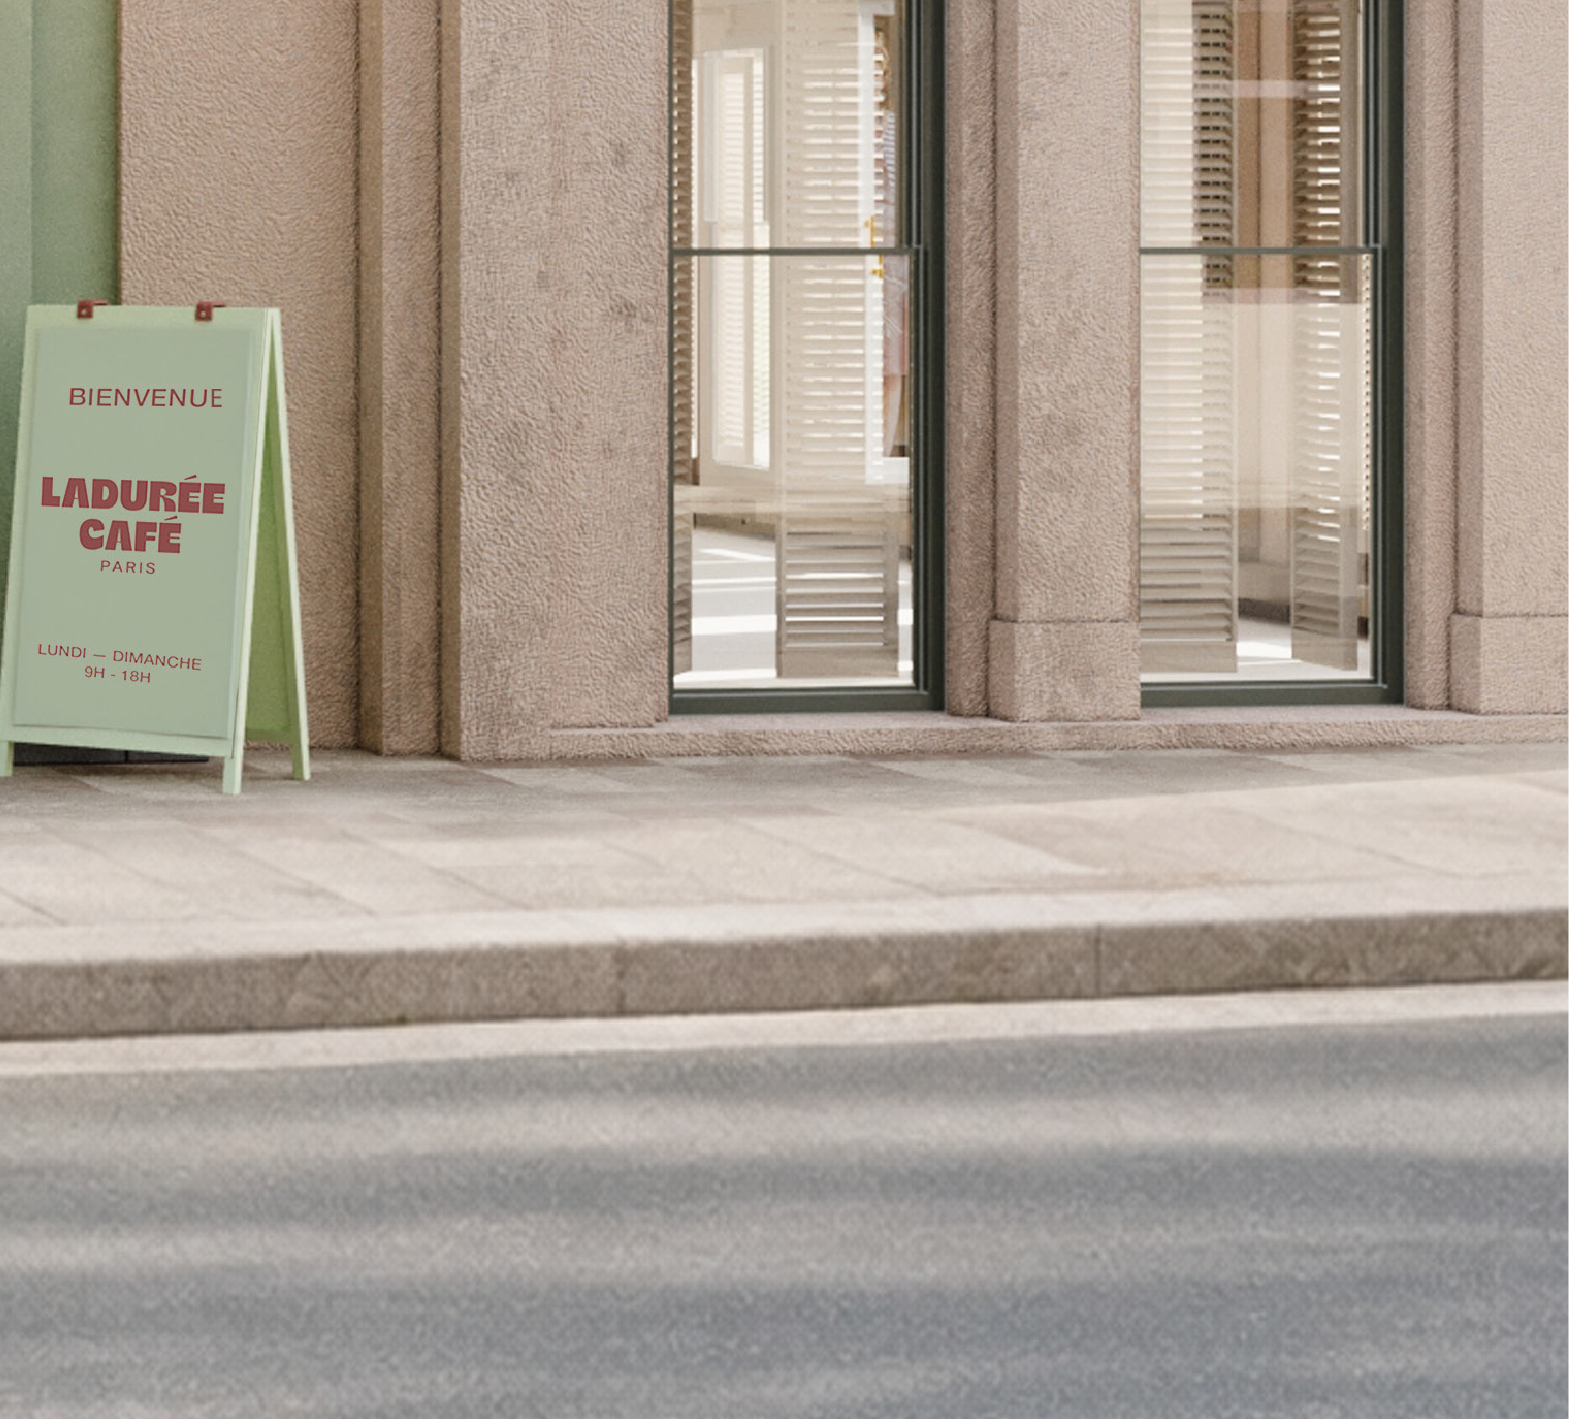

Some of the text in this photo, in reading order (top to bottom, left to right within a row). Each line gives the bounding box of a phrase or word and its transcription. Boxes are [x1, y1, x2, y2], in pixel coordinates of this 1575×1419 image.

[68, 387, 223, 408] BIENVENUE
[40, 474, 226, 515] LADURÉE
[79, 515, 182, 554] CAFÉ
[99, 559, 157, 575] PARIS
[37, 643, 87, 659] LUNDI
[112, 649, 203, 672] DIMANCHE
[84, 665, 106, 679] 9H
[121, 669, 151, 684] 18H
